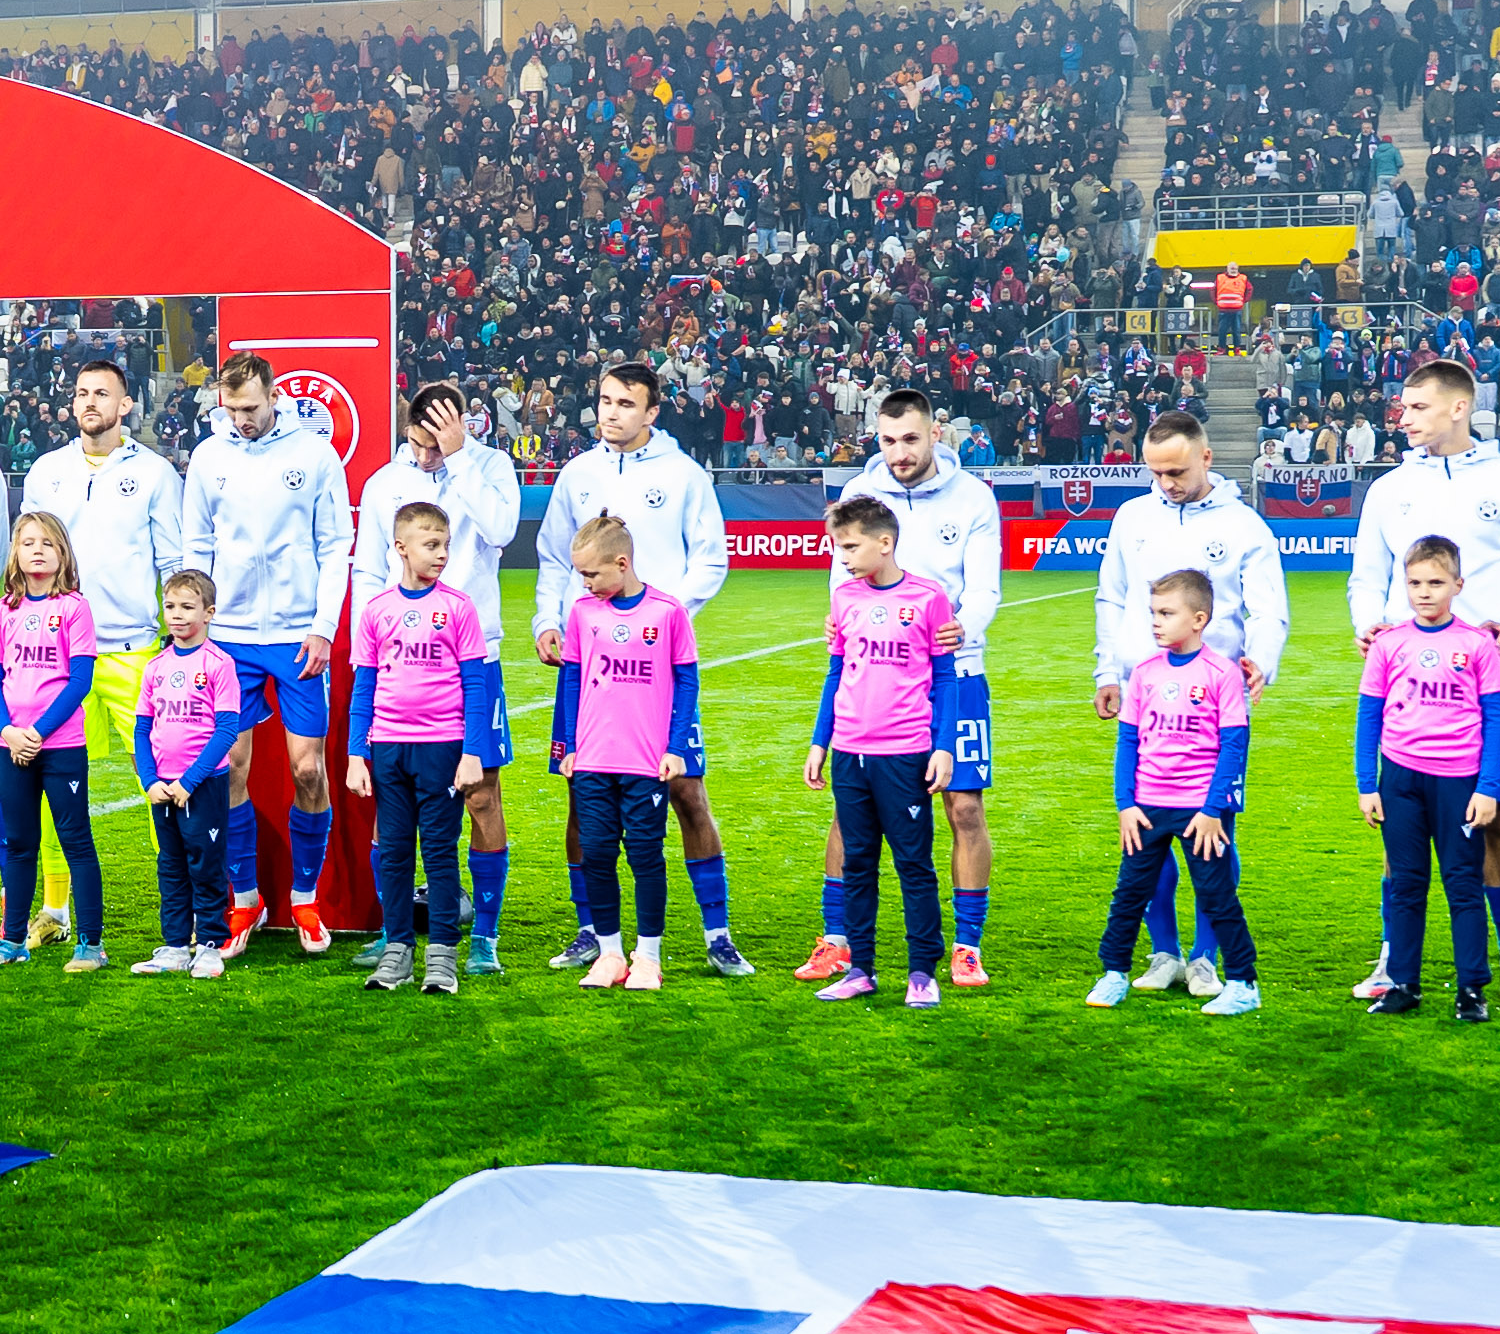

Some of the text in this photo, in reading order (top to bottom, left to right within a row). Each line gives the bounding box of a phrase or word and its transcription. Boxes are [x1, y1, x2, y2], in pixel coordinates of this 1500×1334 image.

[1130, 314, 1146, 330] C4
[1341, 309, 1358, 325] C3
[1050, 466, 1142, 479] ROŽKOVANY
[1272, 467, 1348, 484] KOMÁRNO
[726, 534, 834, 556] EUROPEA
[1023, 537, 1071, 554] FIFA
[1279, 536, 1357, 554] UALIFI
[955, 719, 988, 763] 21
